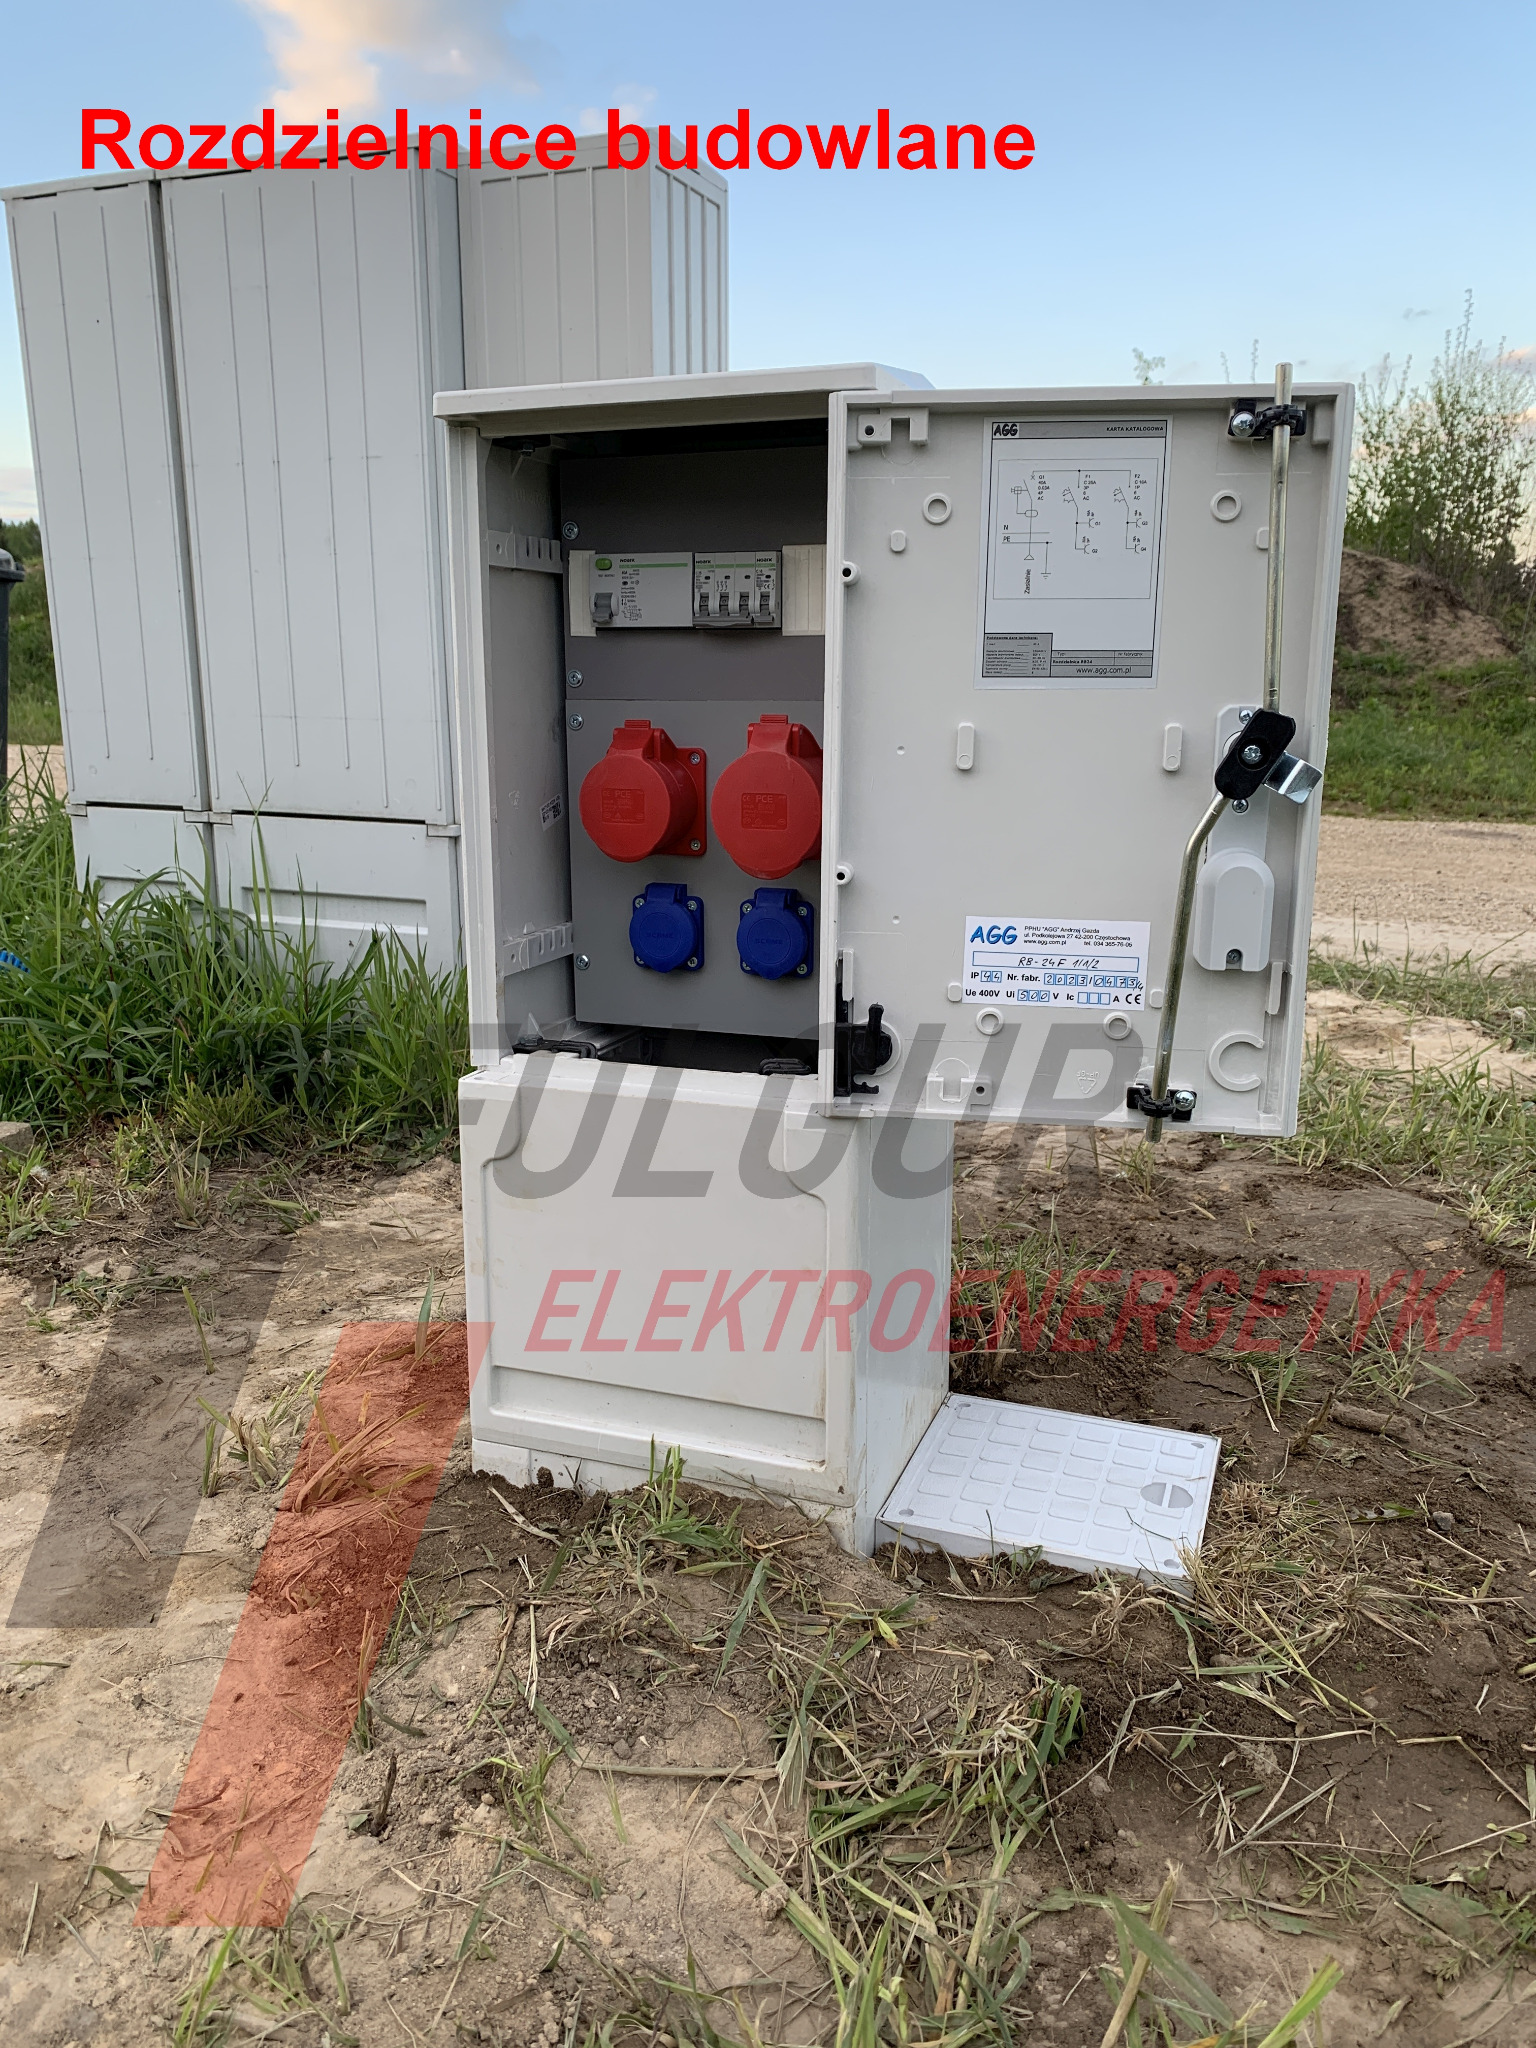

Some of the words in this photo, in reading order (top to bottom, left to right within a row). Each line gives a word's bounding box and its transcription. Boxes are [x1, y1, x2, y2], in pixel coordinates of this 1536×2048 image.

[993, 423, 1019, 437] AGG
[1076, 666, 1132, 675] www.agg.com.pl
[615, 789, 631, 798] PCE
[755, 794, 773, 803] PCE
[969, 924, 1019, 946] AGG
[1094, 934, 1131, 942] Częstochowa
[970, 971, 980, 979] IP
[983, 971, 1001, 983] 44
[1007, 973, 1019, 981] Nr.
[1021, 973, 1041, 982] fabr.
[965, 989, 977, 997] Ue
[979, 989, 1001, 998] 400V
[1006, 990, 1015, 999] Ui
[1019, 990, 1048, 1001] 500
[1052, 992, 1060, 1000] V
[1112, 995, 1120, 1003] A
[1125, 993, 1142, 1005] CE
